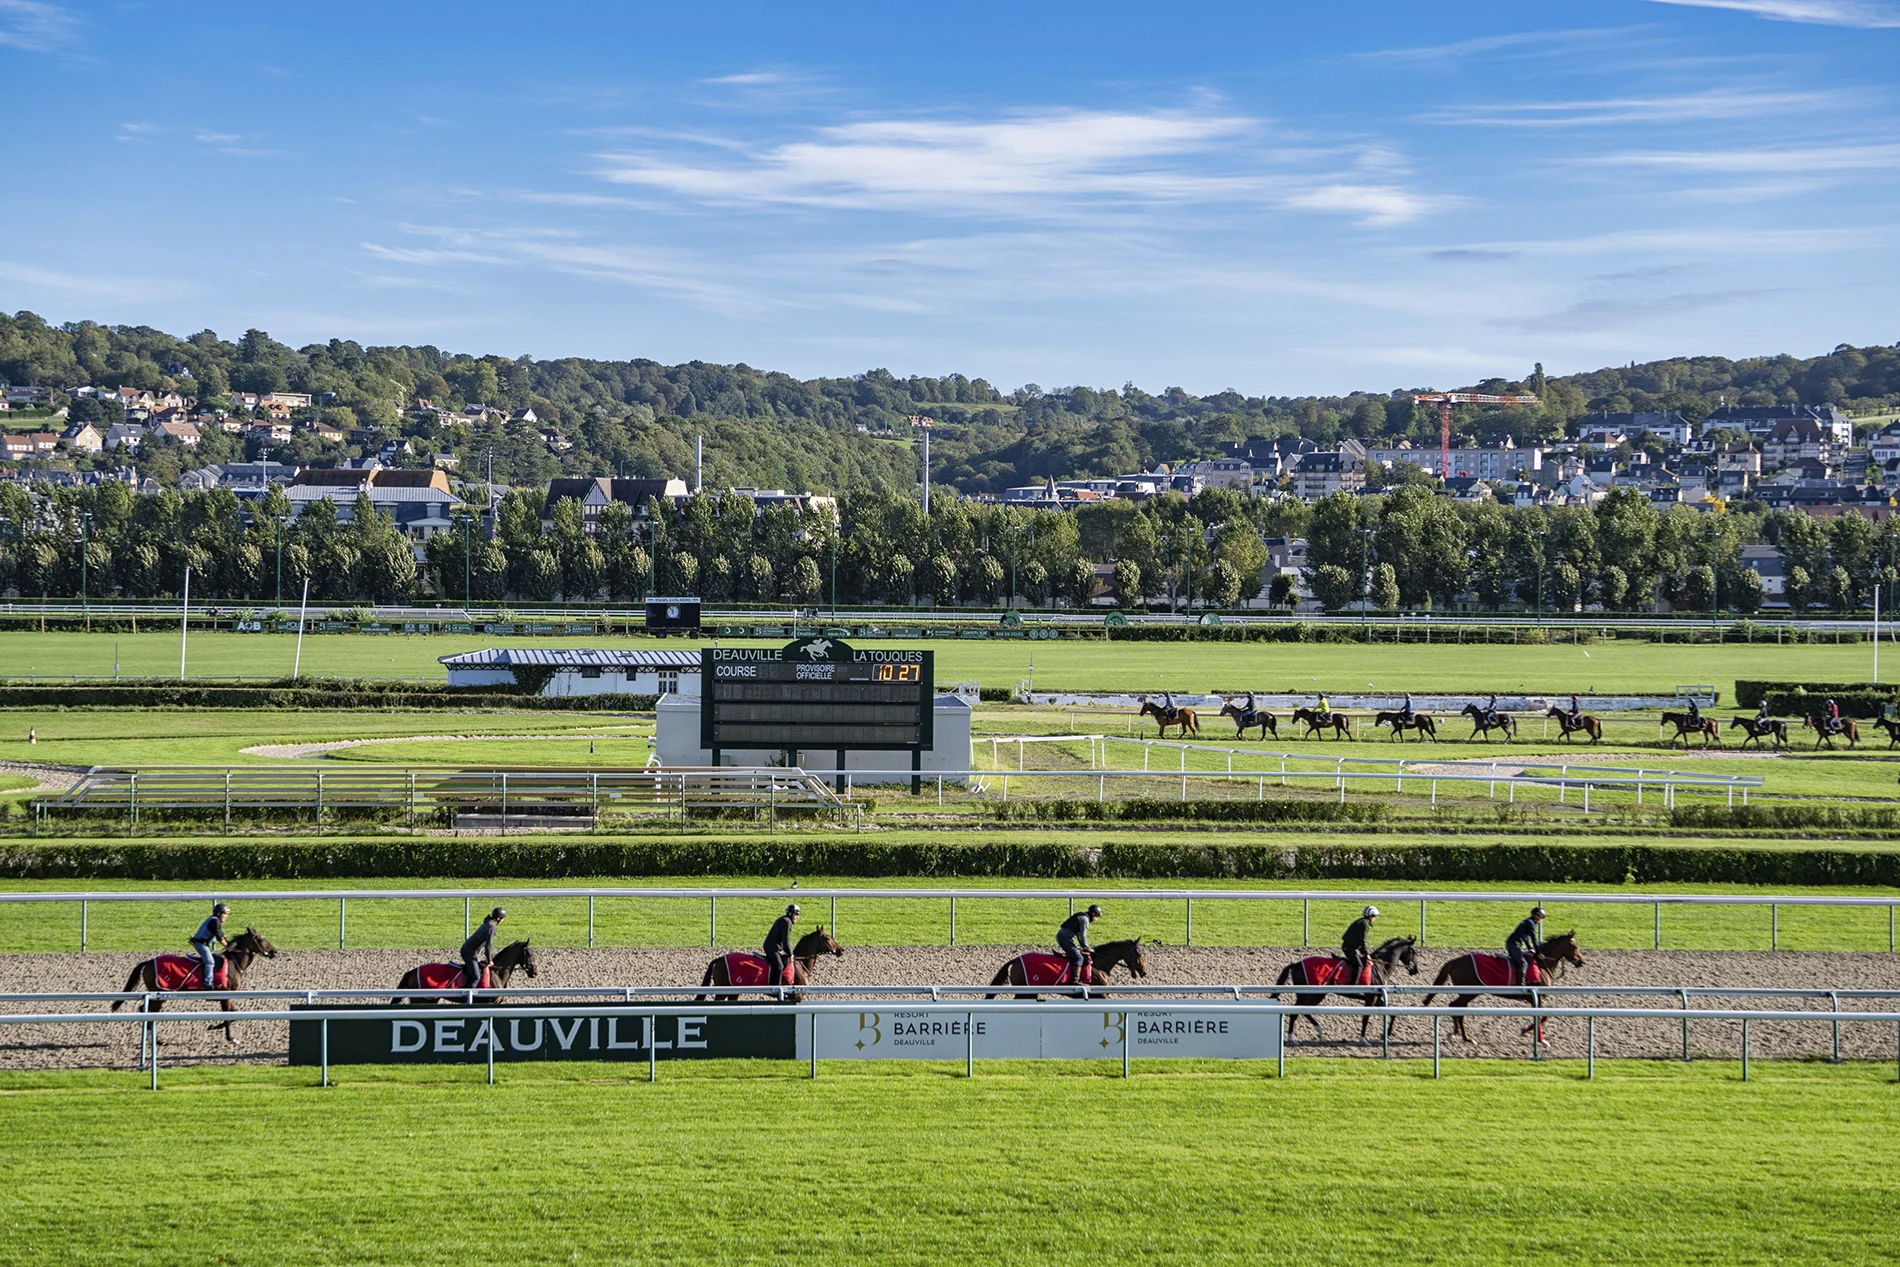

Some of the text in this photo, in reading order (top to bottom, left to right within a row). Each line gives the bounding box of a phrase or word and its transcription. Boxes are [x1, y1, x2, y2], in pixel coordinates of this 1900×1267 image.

[713, 649, 782, 660] DEAUVILLE
[853, 651, 922, 662] LA TOUQUES
[716, 665, 756, 677] COURSE
[796, 664, 835, 672] PROVISOIRE
[796, 672, 832, 680] OFFICIELLE
[894, 1021, 986, 1035] BARRIÈRE
[1138, 1019, 1229, 1034] BARRIÈRE
[390, 1016, 707, 1053] DEAUVILLE
